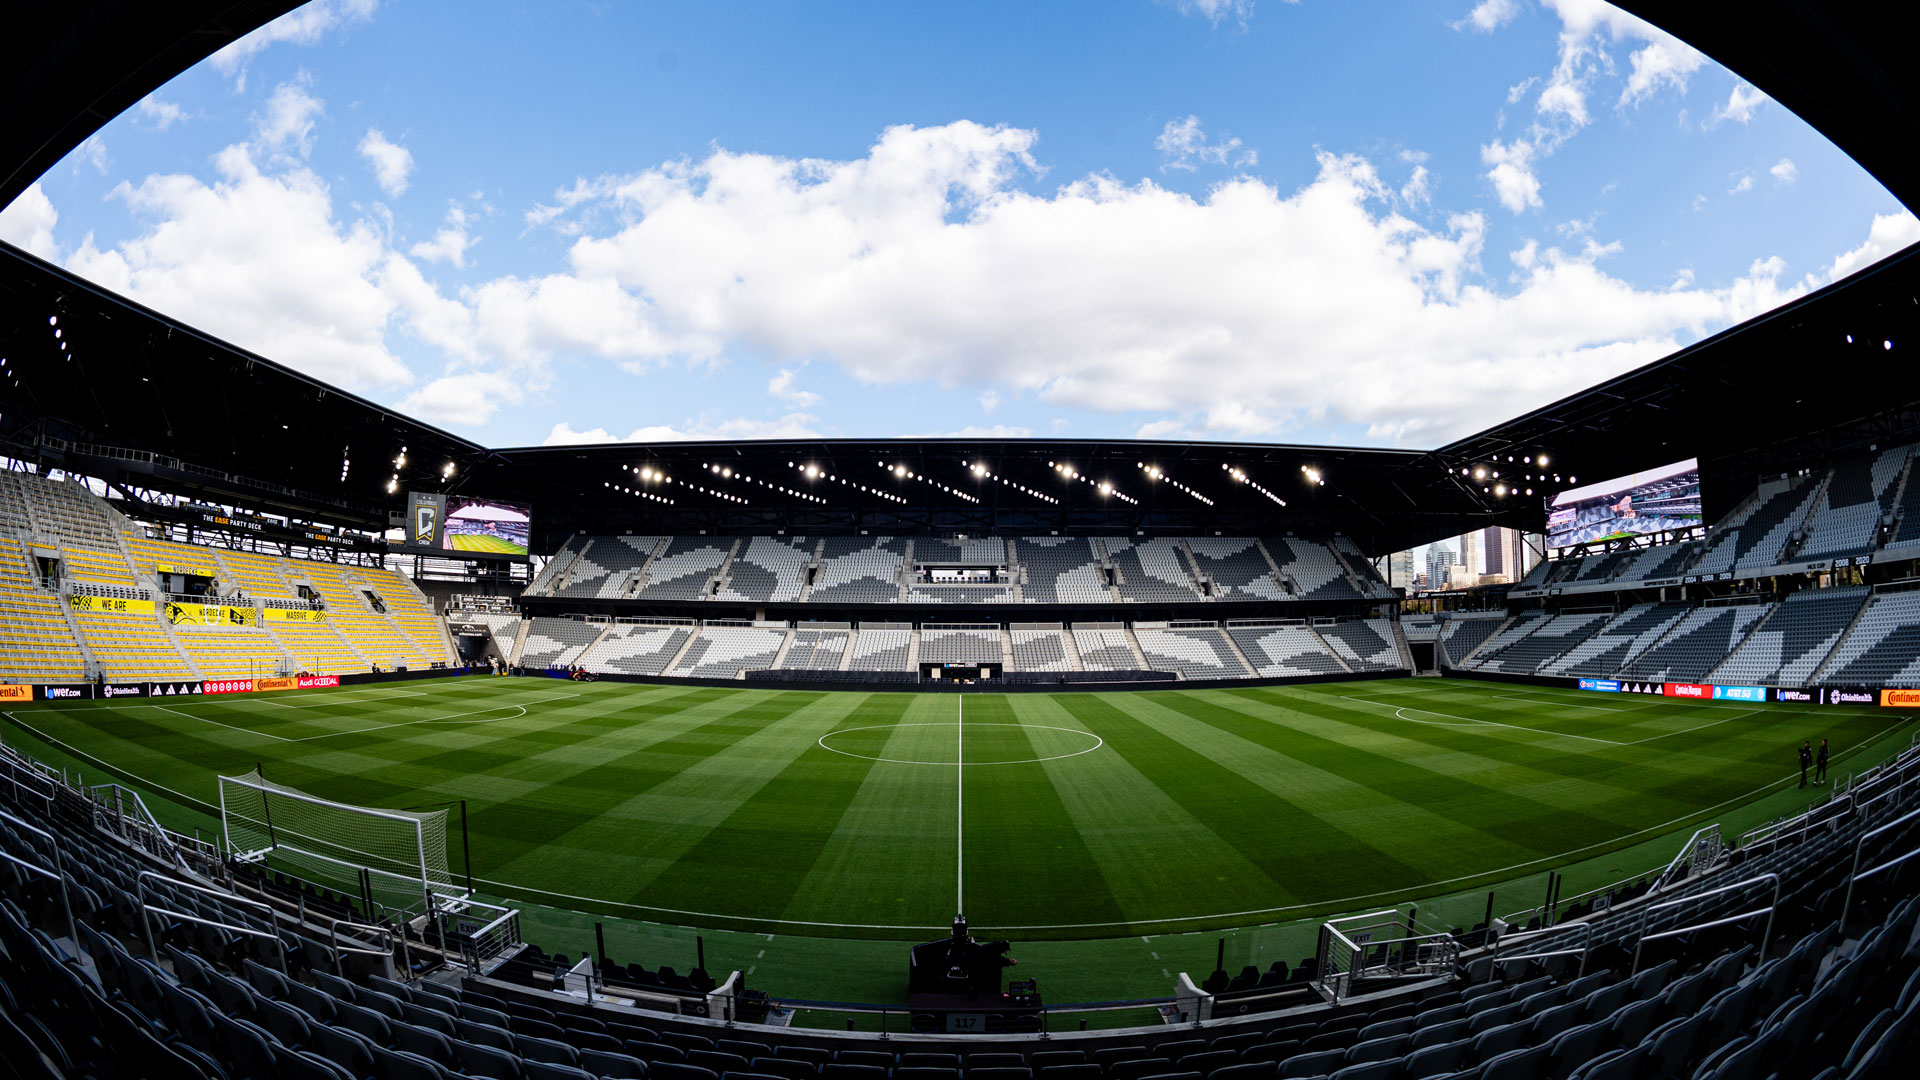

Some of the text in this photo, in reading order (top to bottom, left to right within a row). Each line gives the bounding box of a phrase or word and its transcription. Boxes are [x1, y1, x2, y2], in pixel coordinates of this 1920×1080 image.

[203, 514, 214, 522] THE
[230, 519, 247, 528] PARTY
[247, 522, 262, 530] DECK
[1834, 555, 1870, 567] 2008 2020
[1684, 576, 1697, 584] 2004
[101, 599, 127, 611] WE ARE
[285, 611, 307, 620] MASSIVE
[257, 679, 288, 691] Continental
[299, 678, 314, 687] Audi
[113, 686, 140, 695] OhioHealth
[1726, 688, 1742, 698] AT&T
[1840, 693, 1873, 702] OhioHealth
[460, 923, 478, 934] EXIT
[1354, 934, 1371, 943] EXIT
[955, 1018, 977, 1028] 117
